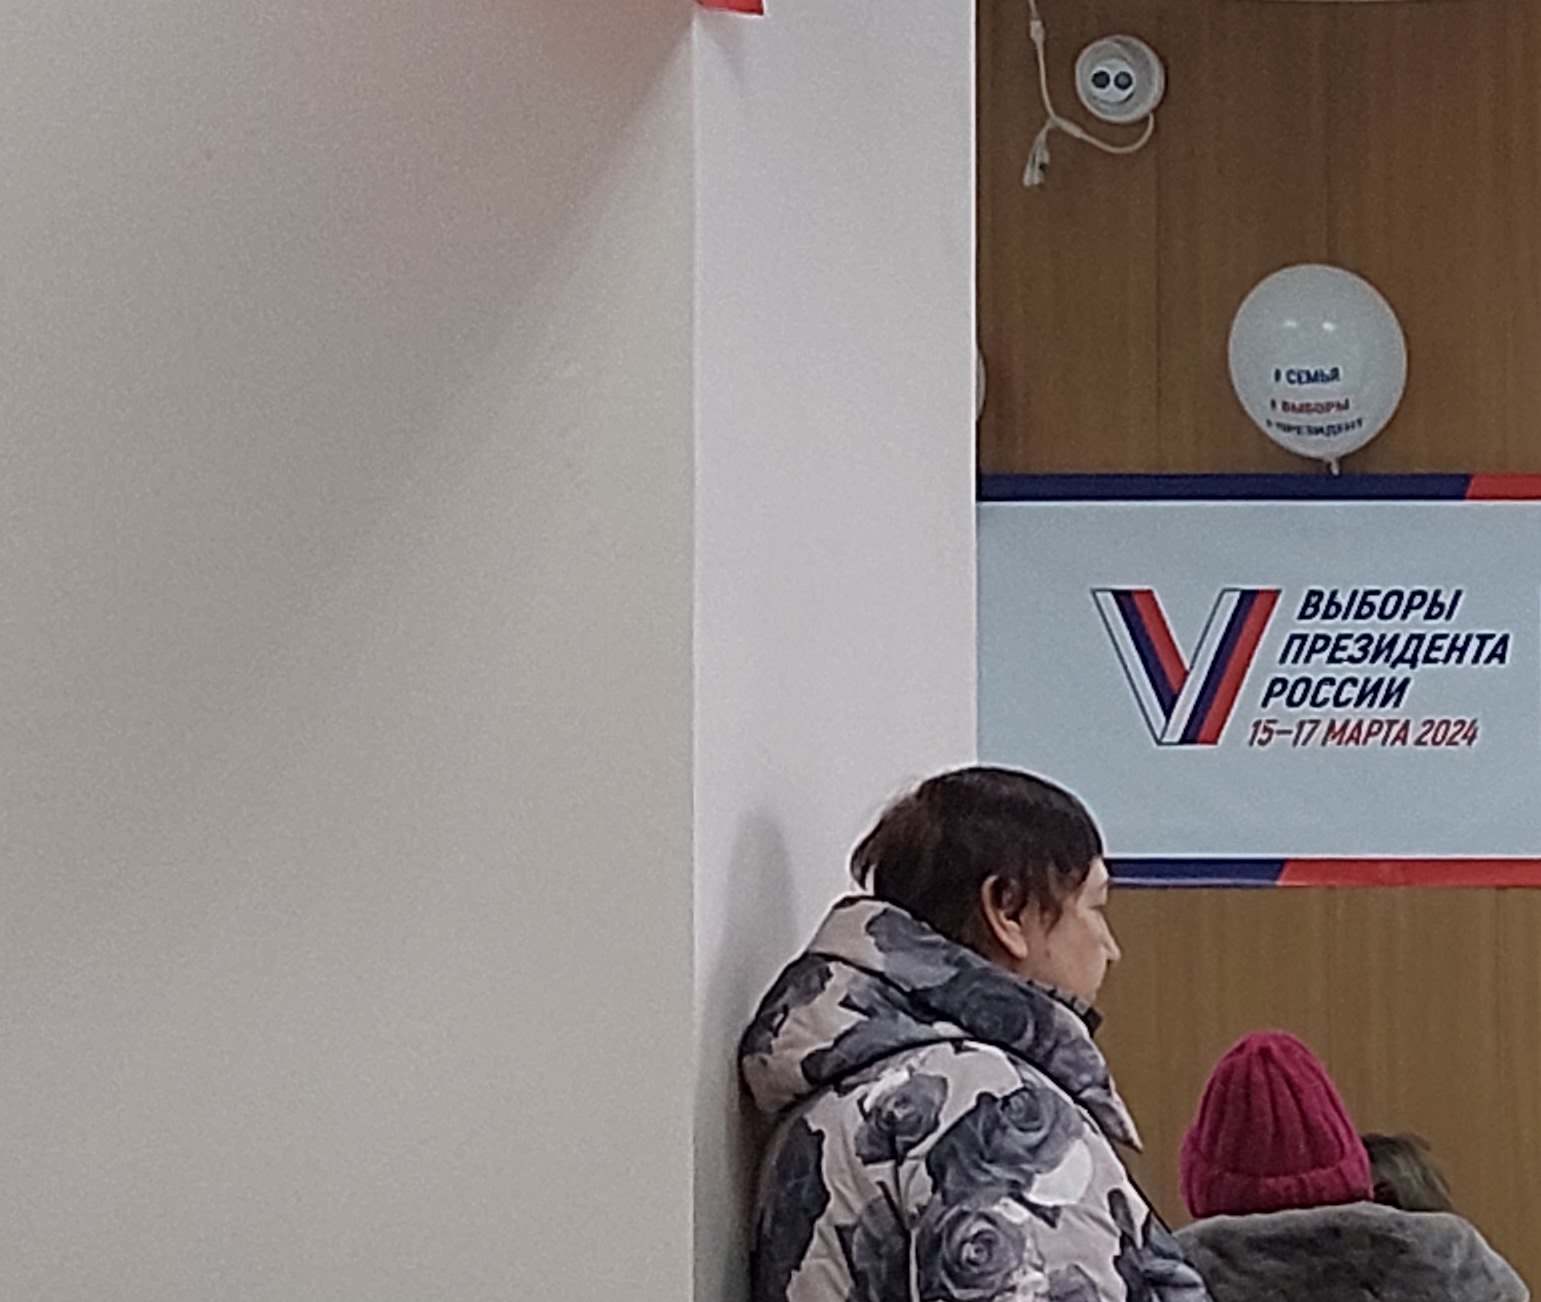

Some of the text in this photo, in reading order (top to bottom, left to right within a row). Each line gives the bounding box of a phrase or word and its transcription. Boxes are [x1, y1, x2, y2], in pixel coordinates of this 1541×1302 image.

[1296, 589, 1464, 621] ВЫБОРЫ
[1279, 633, 1510, 669] ПРЕЗИДЕНТА
[1261, 677, 1411, 709] РОССИИ
[1325, 719, 1411, 747] МАРТА
[1414, 718, 1479, 747] 2024
